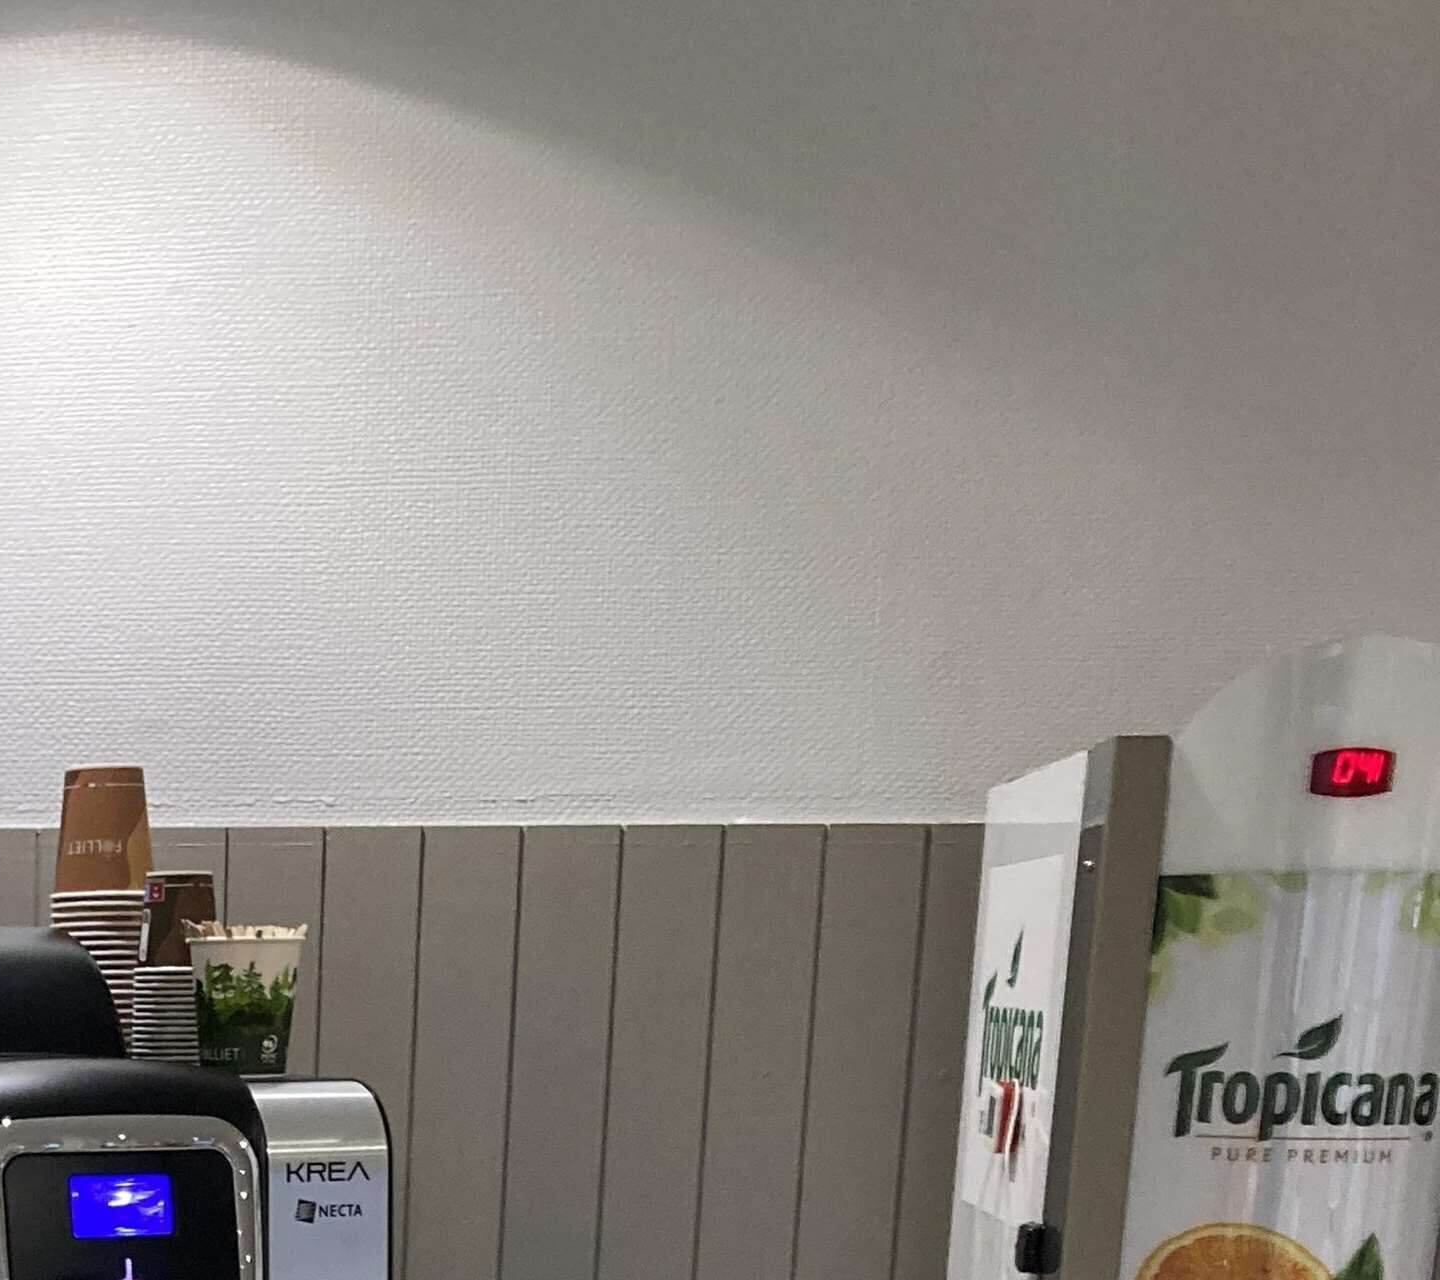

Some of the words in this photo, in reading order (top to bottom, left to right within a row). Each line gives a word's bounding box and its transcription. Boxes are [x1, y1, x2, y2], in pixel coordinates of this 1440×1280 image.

[978, 969, 1044, 1097] Tropicana
[1164, 1042, 1440, 1141] Tropicana
[1210, 1147, 1272, 1162] PURE
[1287, 1149, 1393, 1164] PREMIUM
[286, 1161, 370, 1183] KREA
[318, 1204, 363, 1218] NECTA
